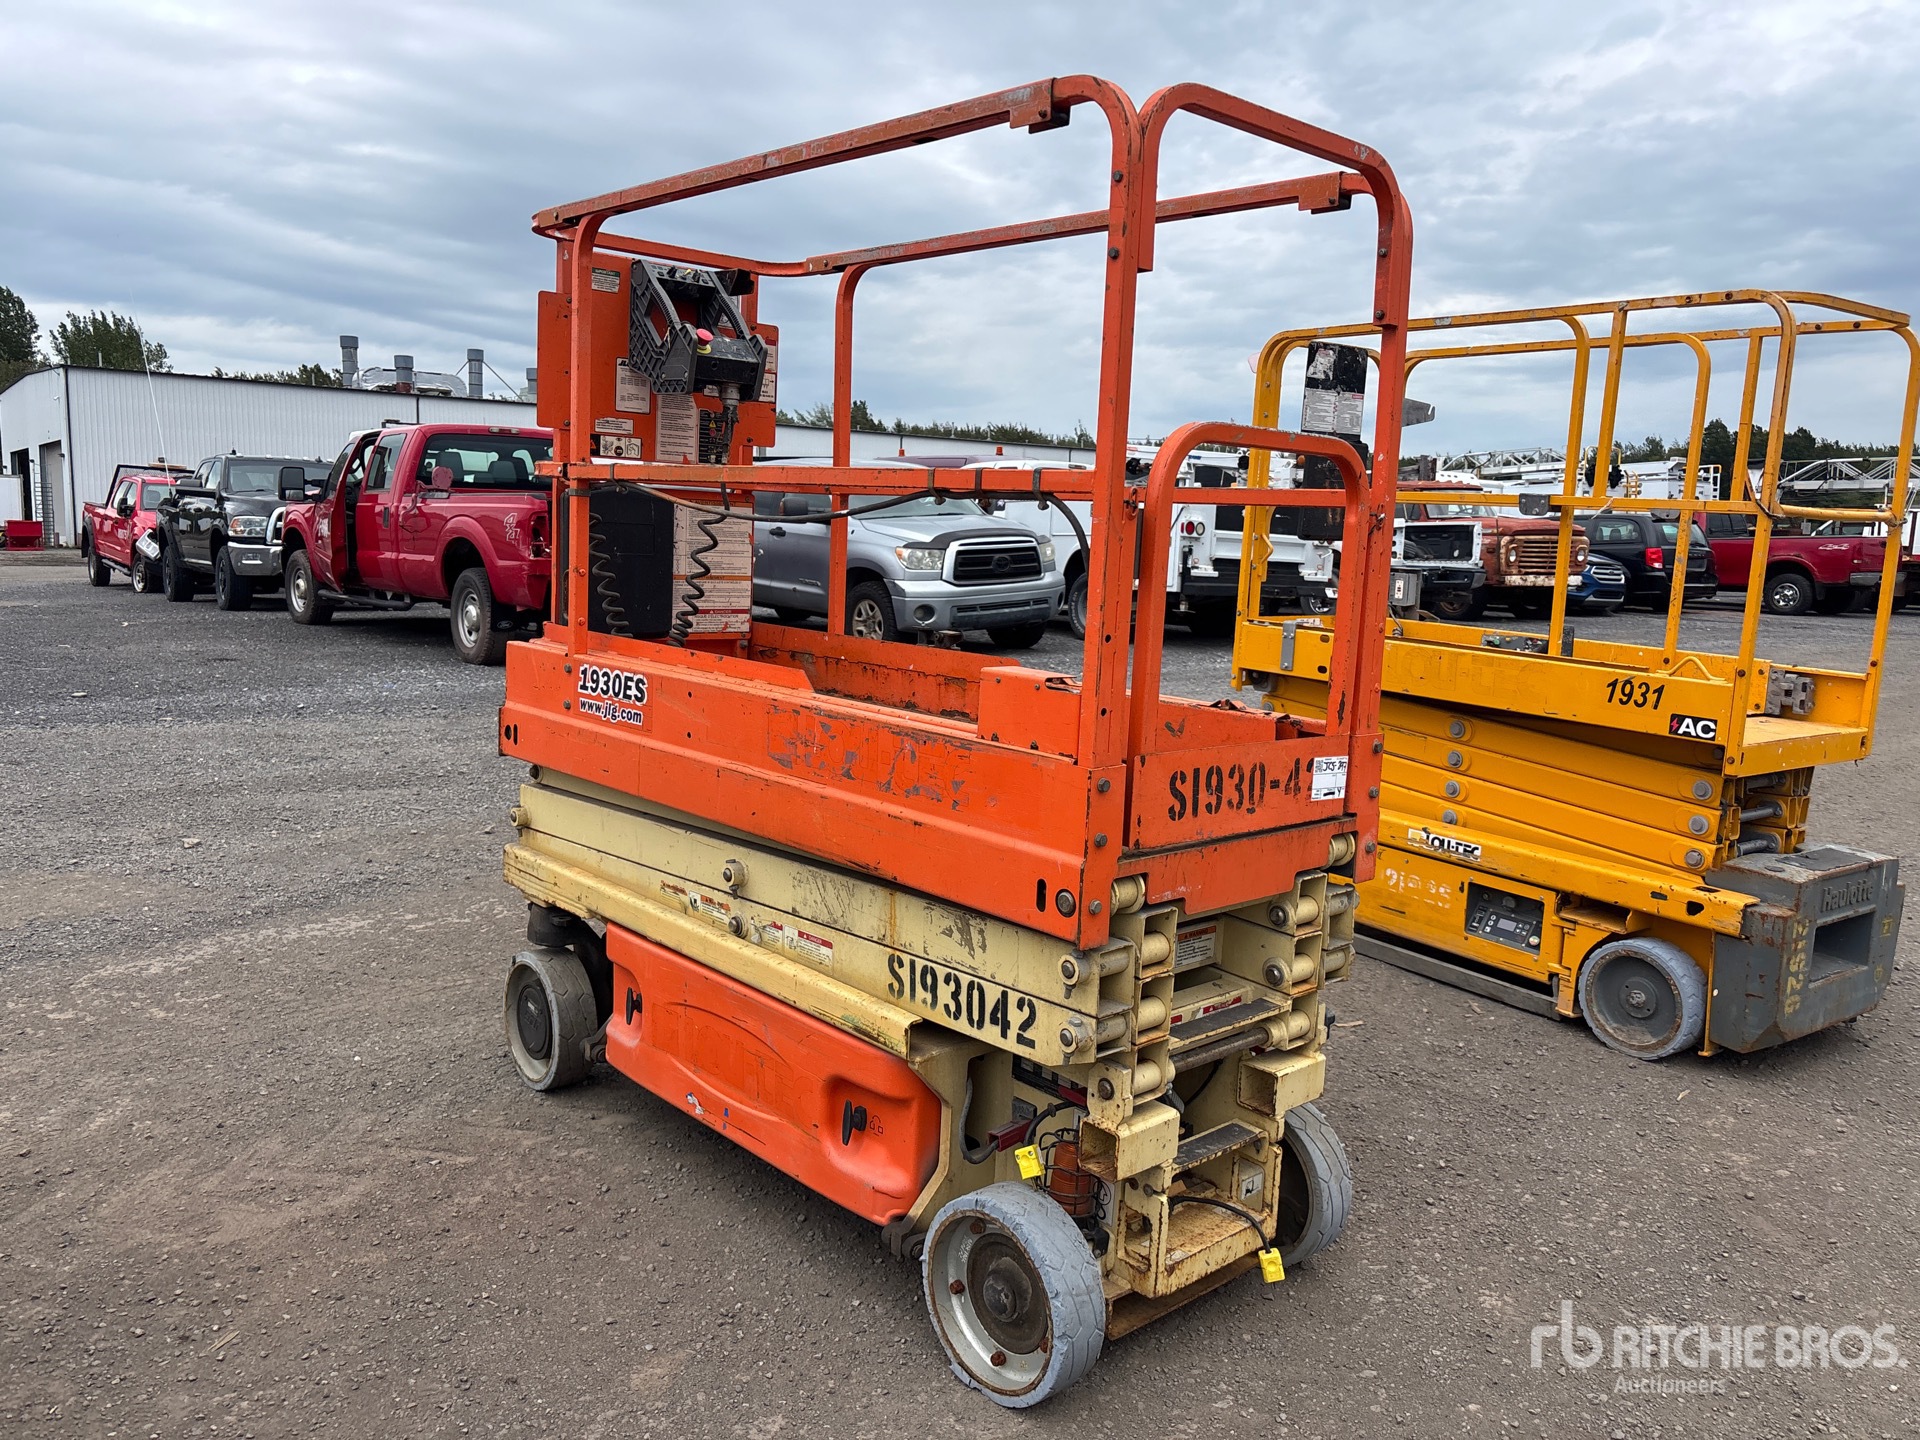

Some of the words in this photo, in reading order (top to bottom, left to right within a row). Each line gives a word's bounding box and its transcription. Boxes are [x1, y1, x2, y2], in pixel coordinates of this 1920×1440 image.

[579, 666, 646, 703] 1930ES
[1606, 678, 1665, 710] 1931
[580, 699, 642, 724] www.jlg.com
[1677, 717, 1716, 739] AC
[887, 953, 1037, 1050] S193042
